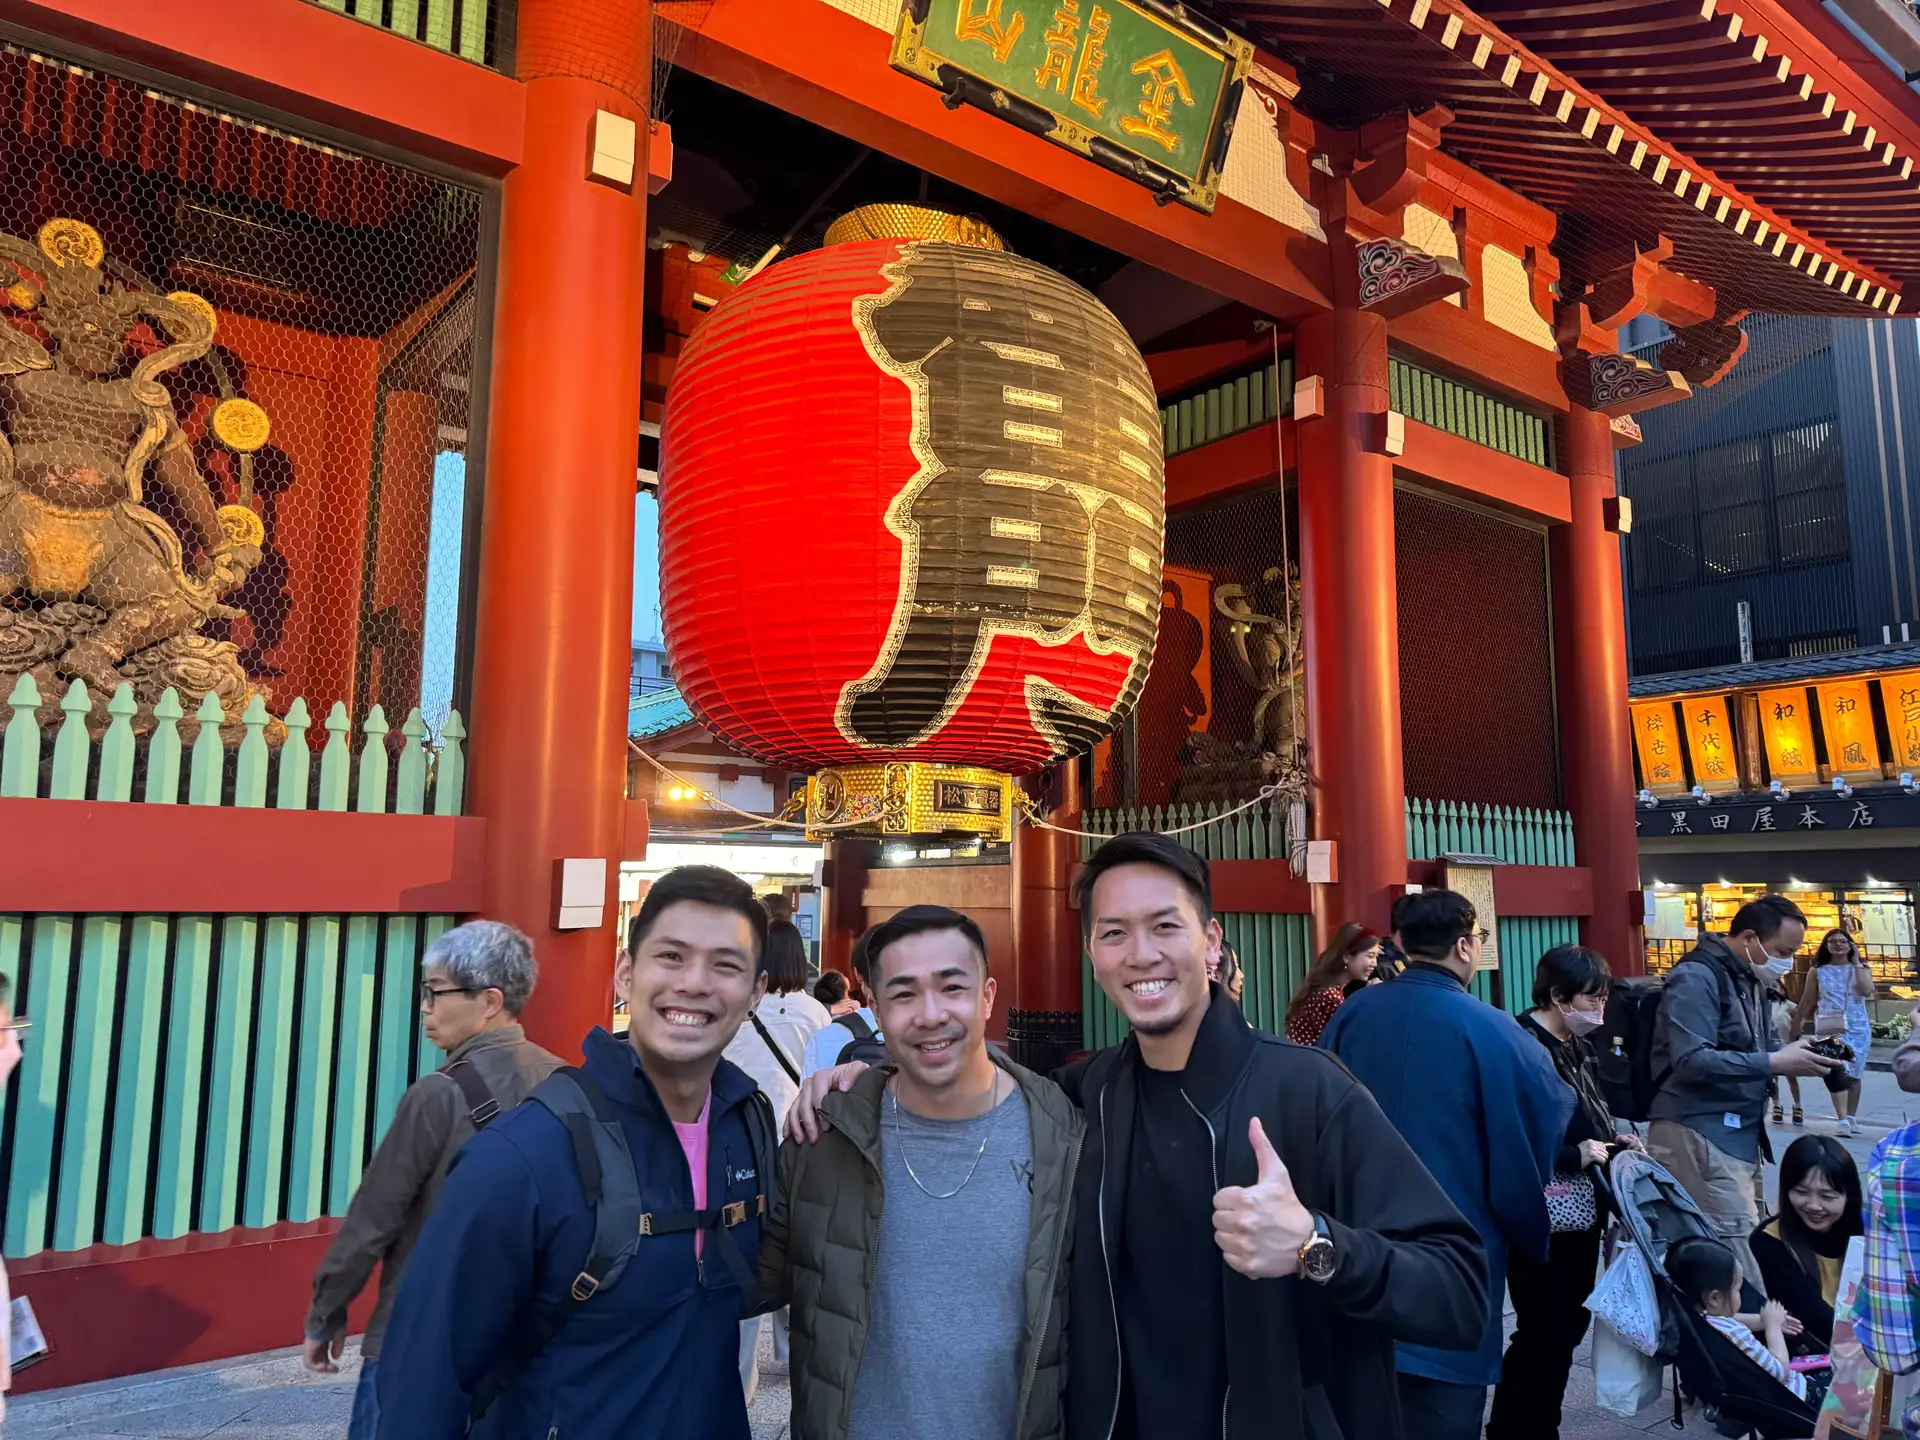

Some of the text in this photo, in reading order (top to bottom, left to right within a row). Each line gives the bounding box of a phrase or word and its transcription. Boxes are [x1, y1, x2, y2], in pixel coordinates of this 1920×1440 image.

[1697, 710, 1725, 776] 千代紙
[943, 785, 999, 810] 松下電器
[1670, 800, 1874, 835] 黒田屋本店
